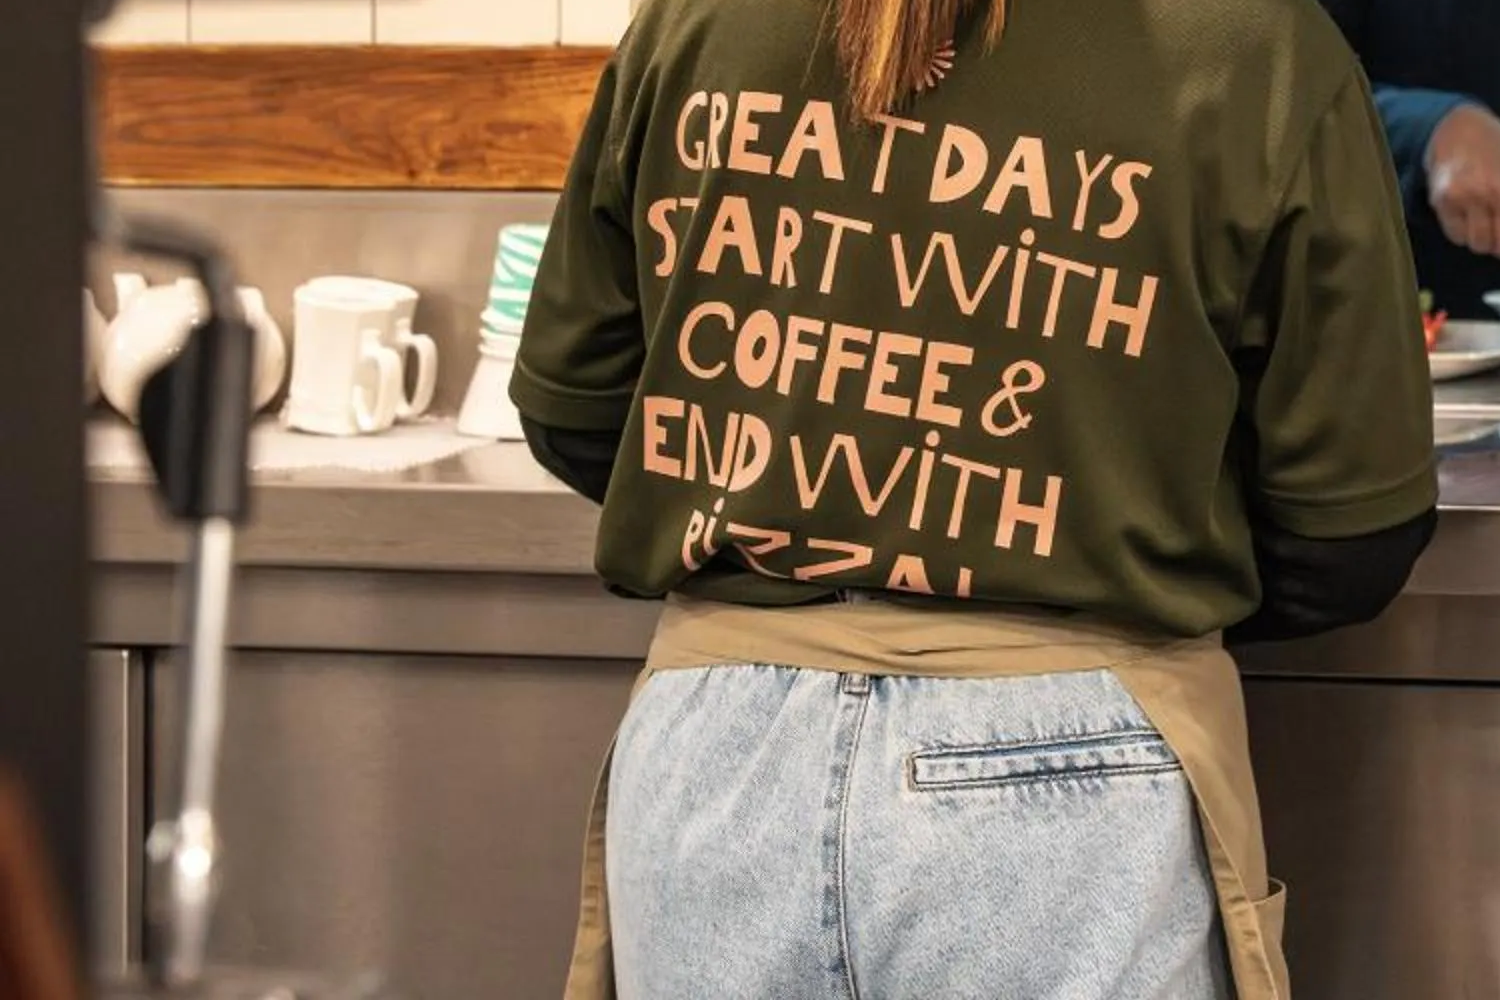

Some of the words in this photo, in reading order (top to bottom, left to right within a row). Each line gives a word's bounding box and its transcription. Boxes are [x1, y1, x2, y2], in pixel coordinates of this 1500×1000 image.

[675, 91, 925, 195] GREAT
[929, 123, 1153, 239] DAYS
[677, 301, 974, 428] COFFEE
[980, 359, 1046, 437] &
[642, 396, 773, 494] END
